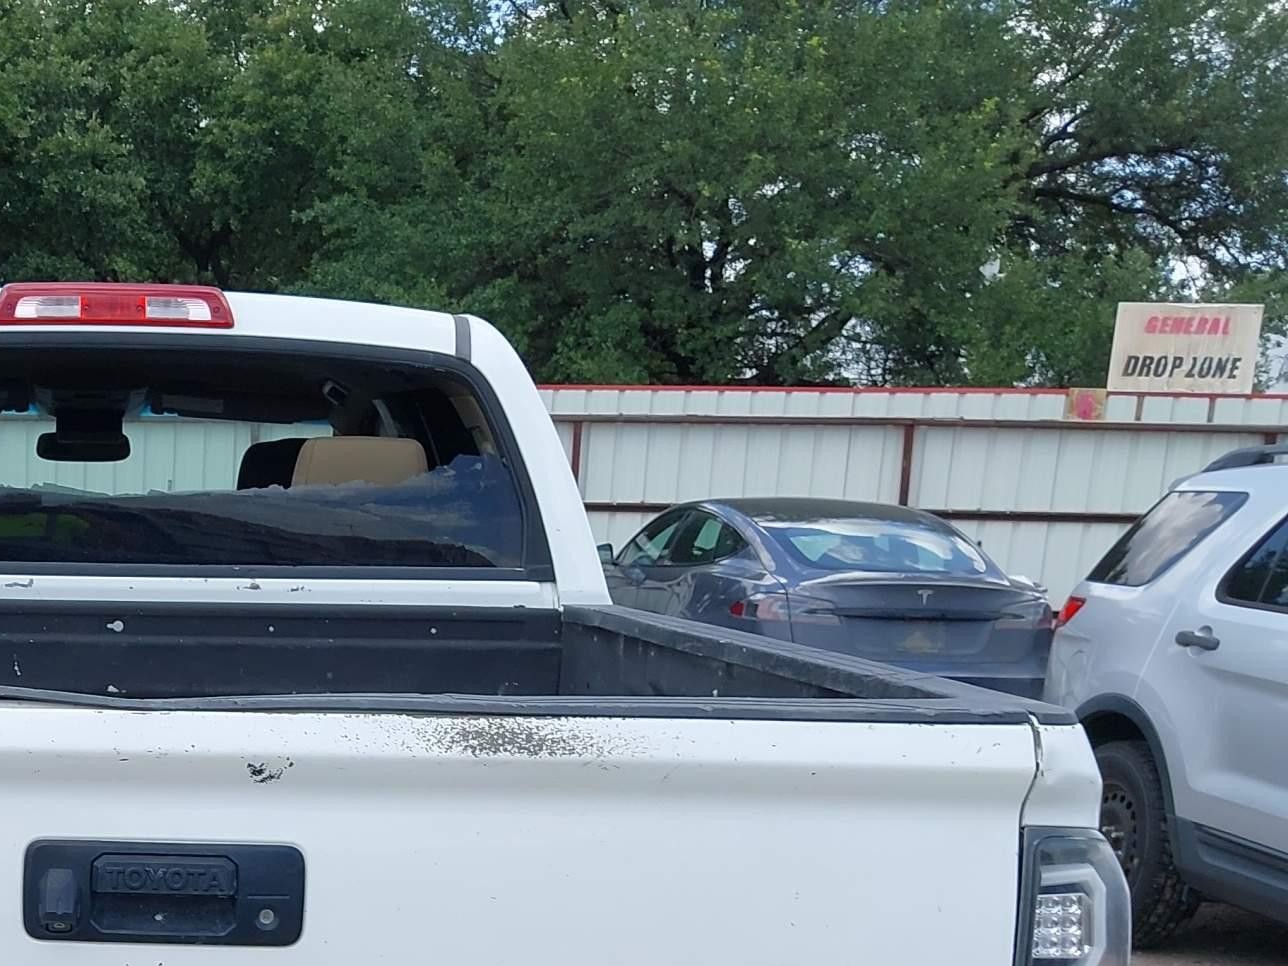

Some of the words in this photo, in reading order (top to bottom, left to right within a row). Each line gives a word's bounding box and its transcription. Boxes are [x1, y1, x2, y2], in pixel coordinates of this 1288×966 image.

[1144, 316, 1232, 335] GENERAL
[1122, 355, 1183, 378] DROP
[1185, 355, 1242, 379] ZONE
[106, 866, 226, 892] TOYOTA
